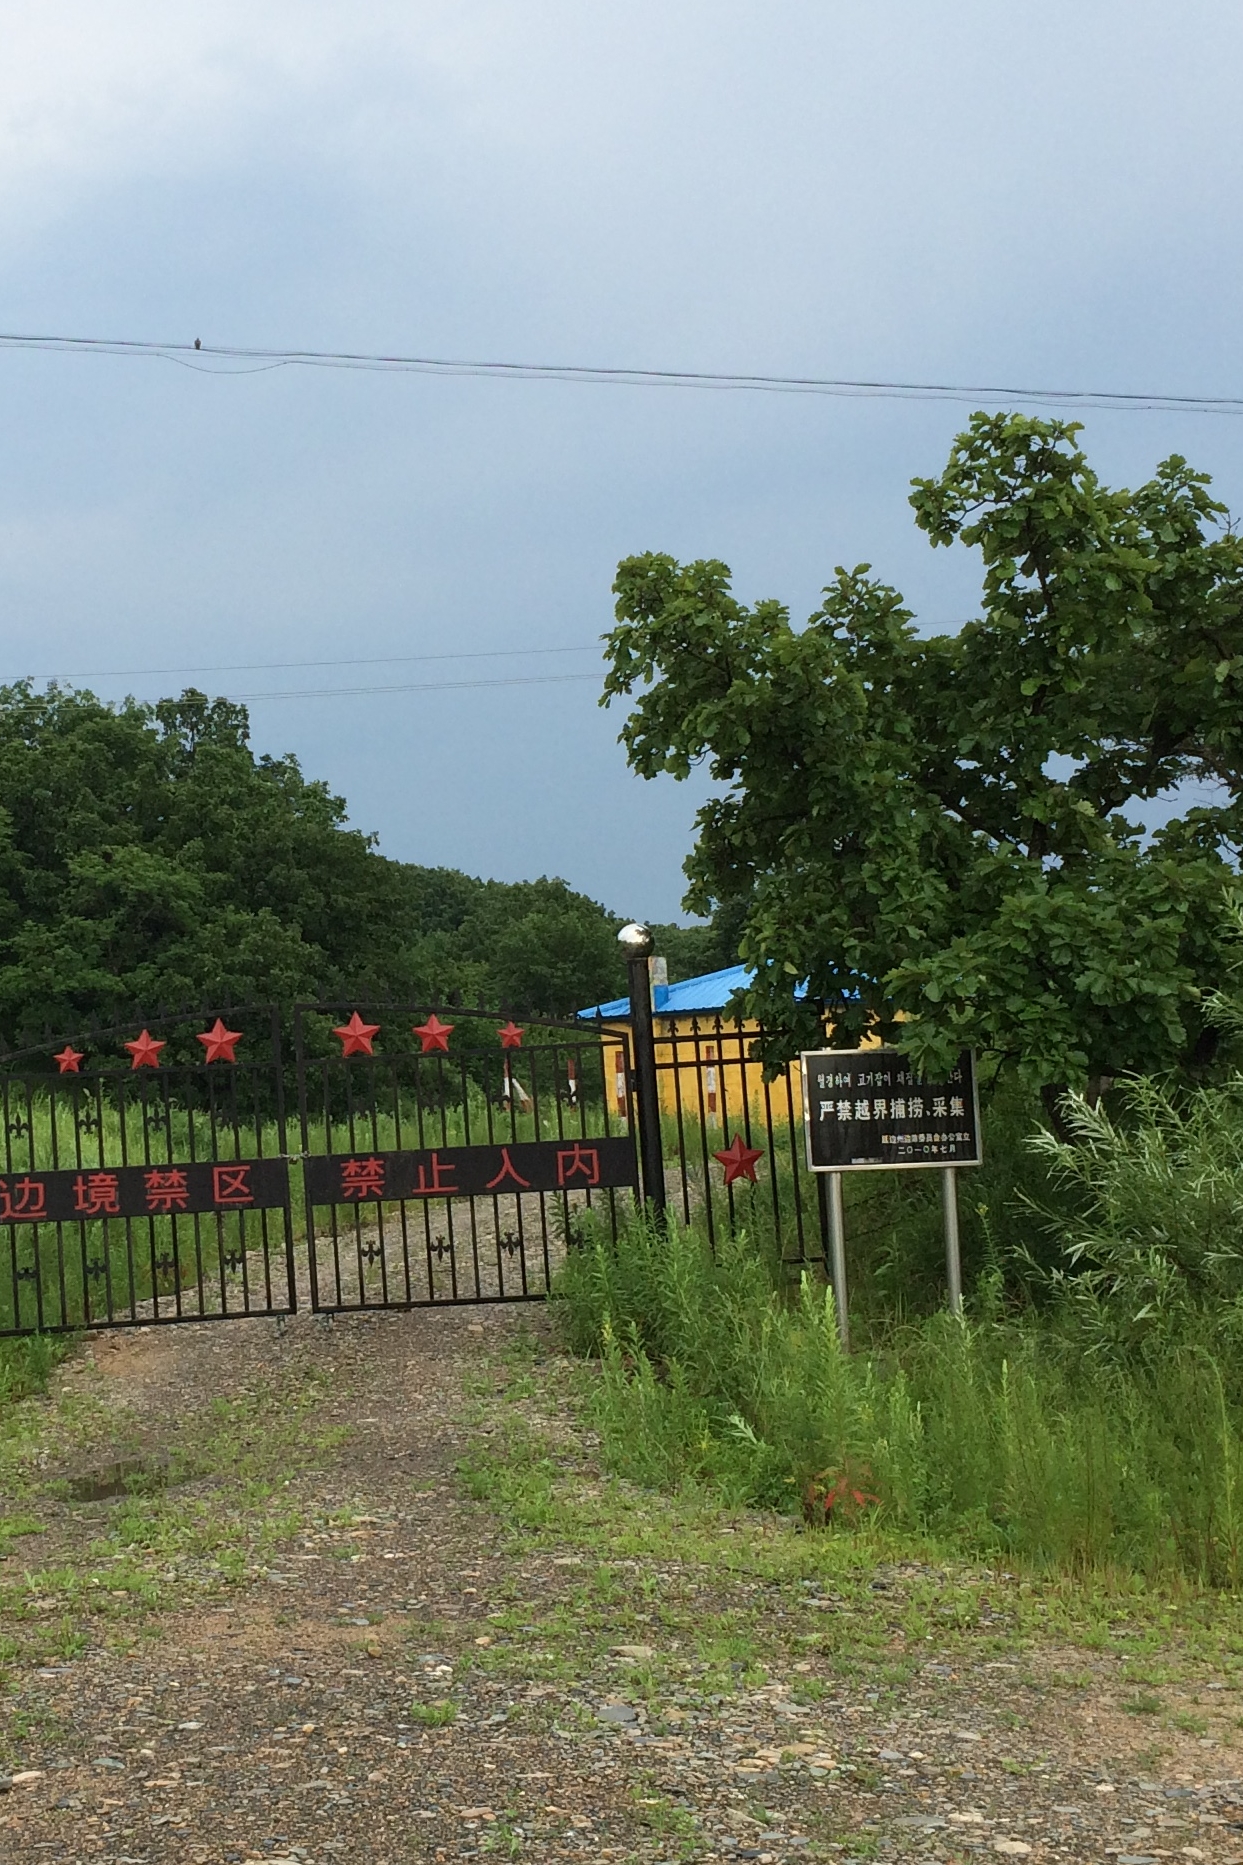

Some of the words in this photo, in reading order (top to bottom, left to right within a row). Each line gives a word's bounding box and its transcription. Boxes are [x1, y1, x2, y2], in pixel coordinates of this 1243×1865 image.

[819, 1095, 965, 1122] 严禁越界捕捞、采集
[340, 1143, 600, 1198] 禁止入内
